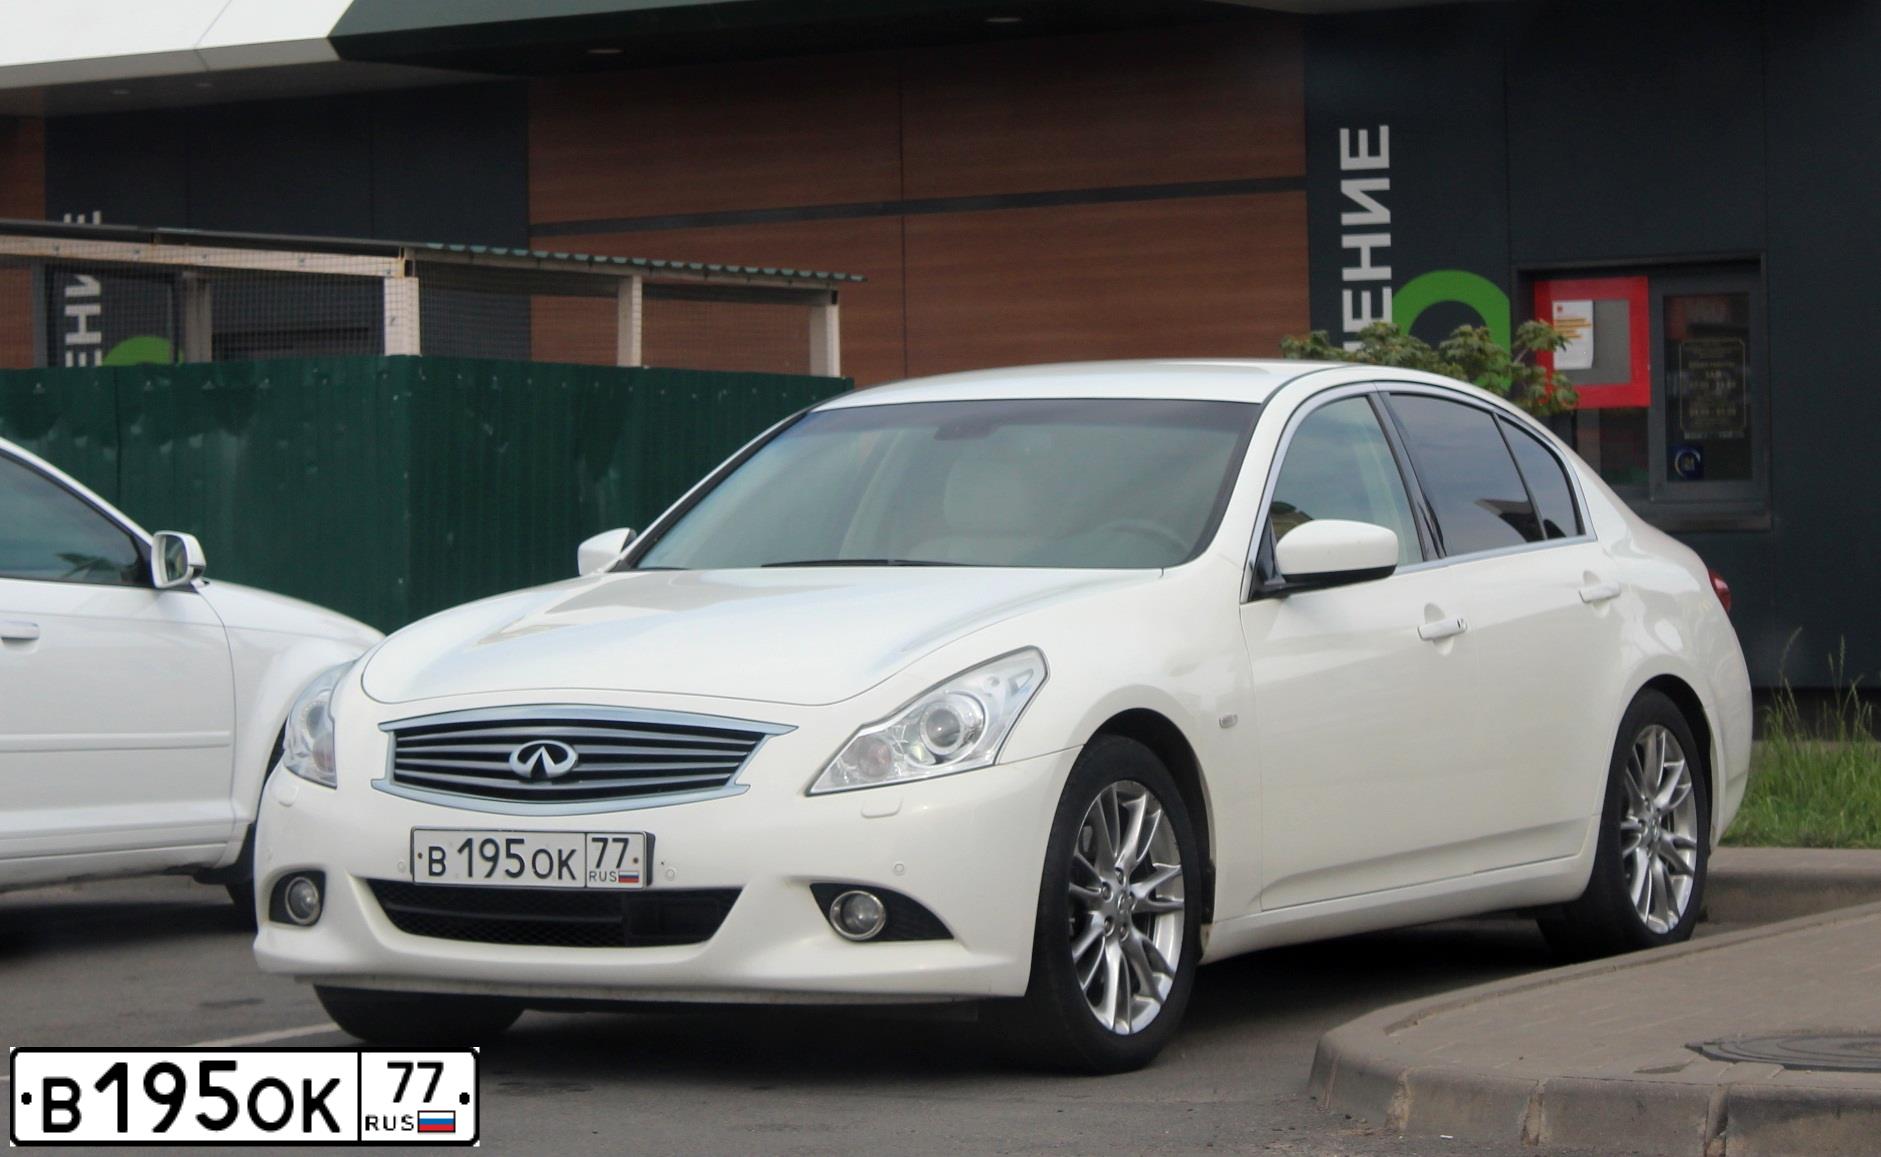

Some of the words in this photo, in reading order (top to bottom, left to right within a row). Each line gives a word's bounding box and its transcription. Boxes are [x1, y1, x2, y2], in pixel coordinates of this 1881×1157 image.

[1340, 125, 1392, 350] ЕНИЕ
[591, 836, 630, 869] 77
[588, 870, 617, 882] RUS
